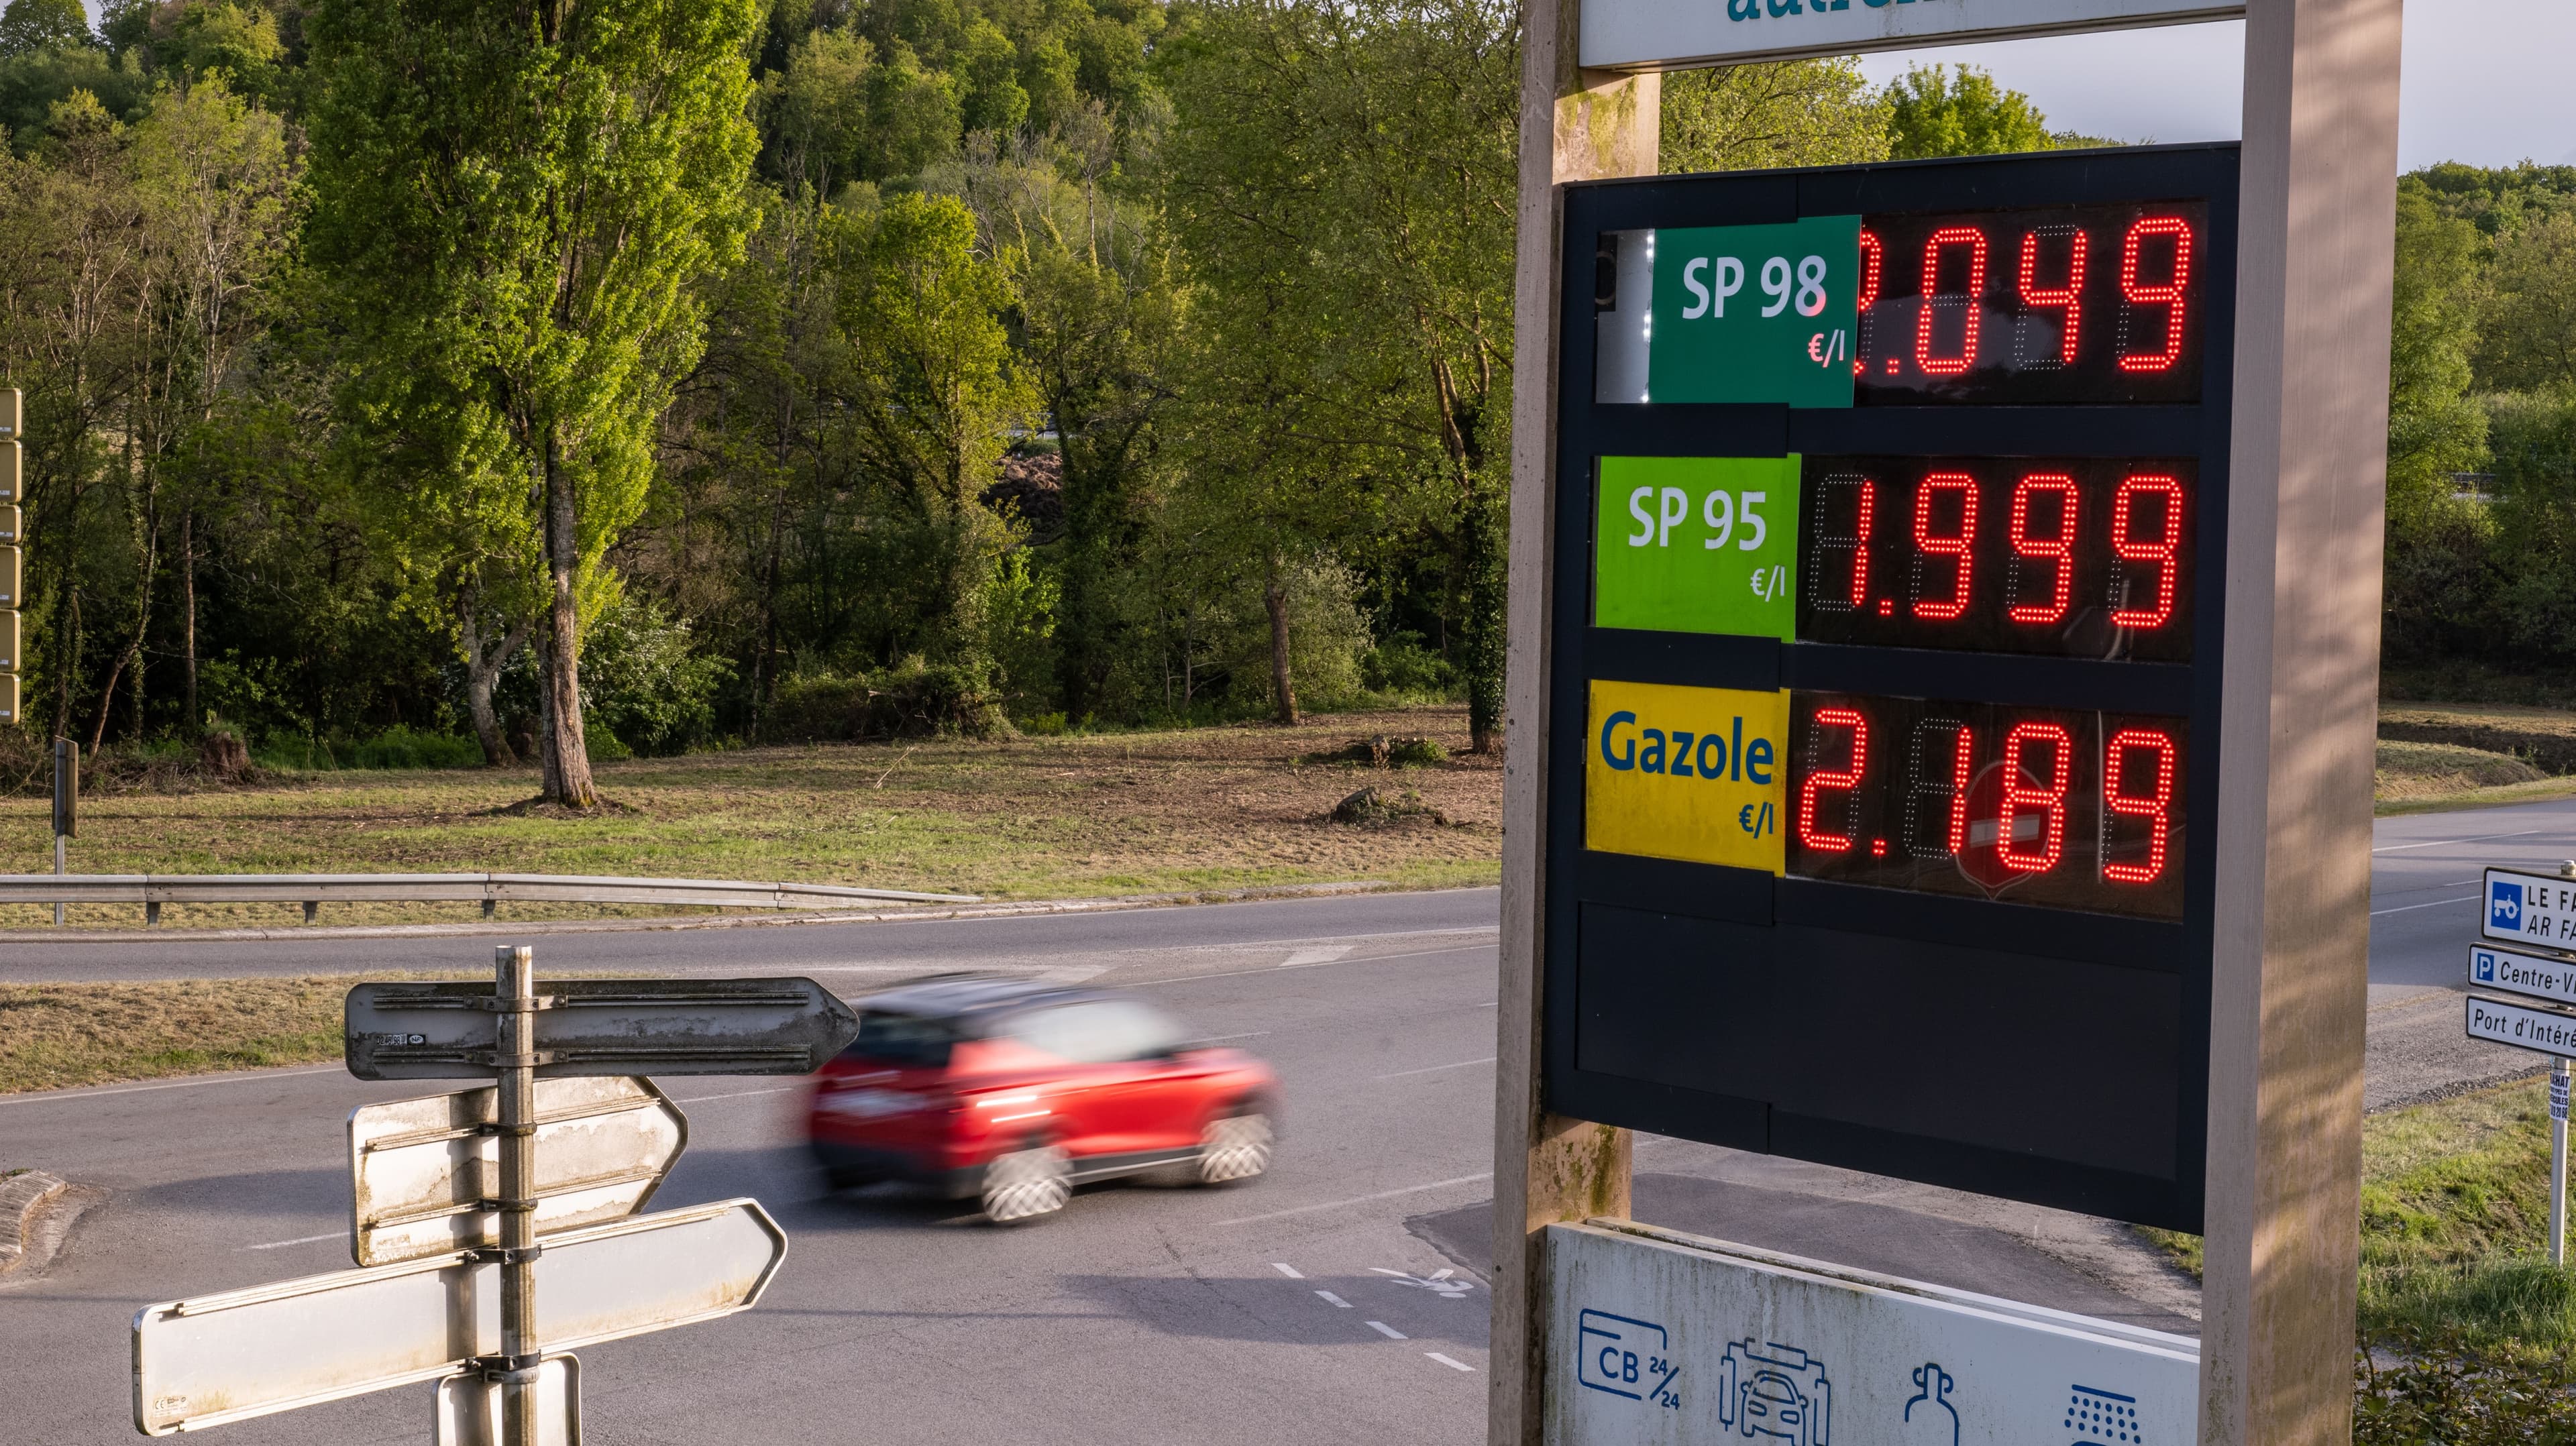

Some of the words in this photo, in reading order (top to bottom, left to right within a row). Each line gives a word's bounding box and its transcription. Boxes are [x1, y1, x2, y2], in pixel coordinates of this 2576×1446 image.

[1682, 256, 1744, 319] SP
[1760, 255, 1827, 318] 98
[1808, 329, 1845, 368] €/l
[1629, 486, 1688, 548] SP
[1704, 491, 1766, 551] 95
[1854, 474, 2183, 628] 1.999
[1750, 564, 1784, 598] €/l
[1601, 711, 1774, 785] Gazole
[1799, 708, 2175, 883] 2.189
[1739, 802, 1774, 840] €/l
[2528, 885, 2548, 908] LE
[2527, 915, 2551, 937] AR
[2474, 1009, 2506, 1034] Port
[1599, 1347, 1638, 1384] CB
